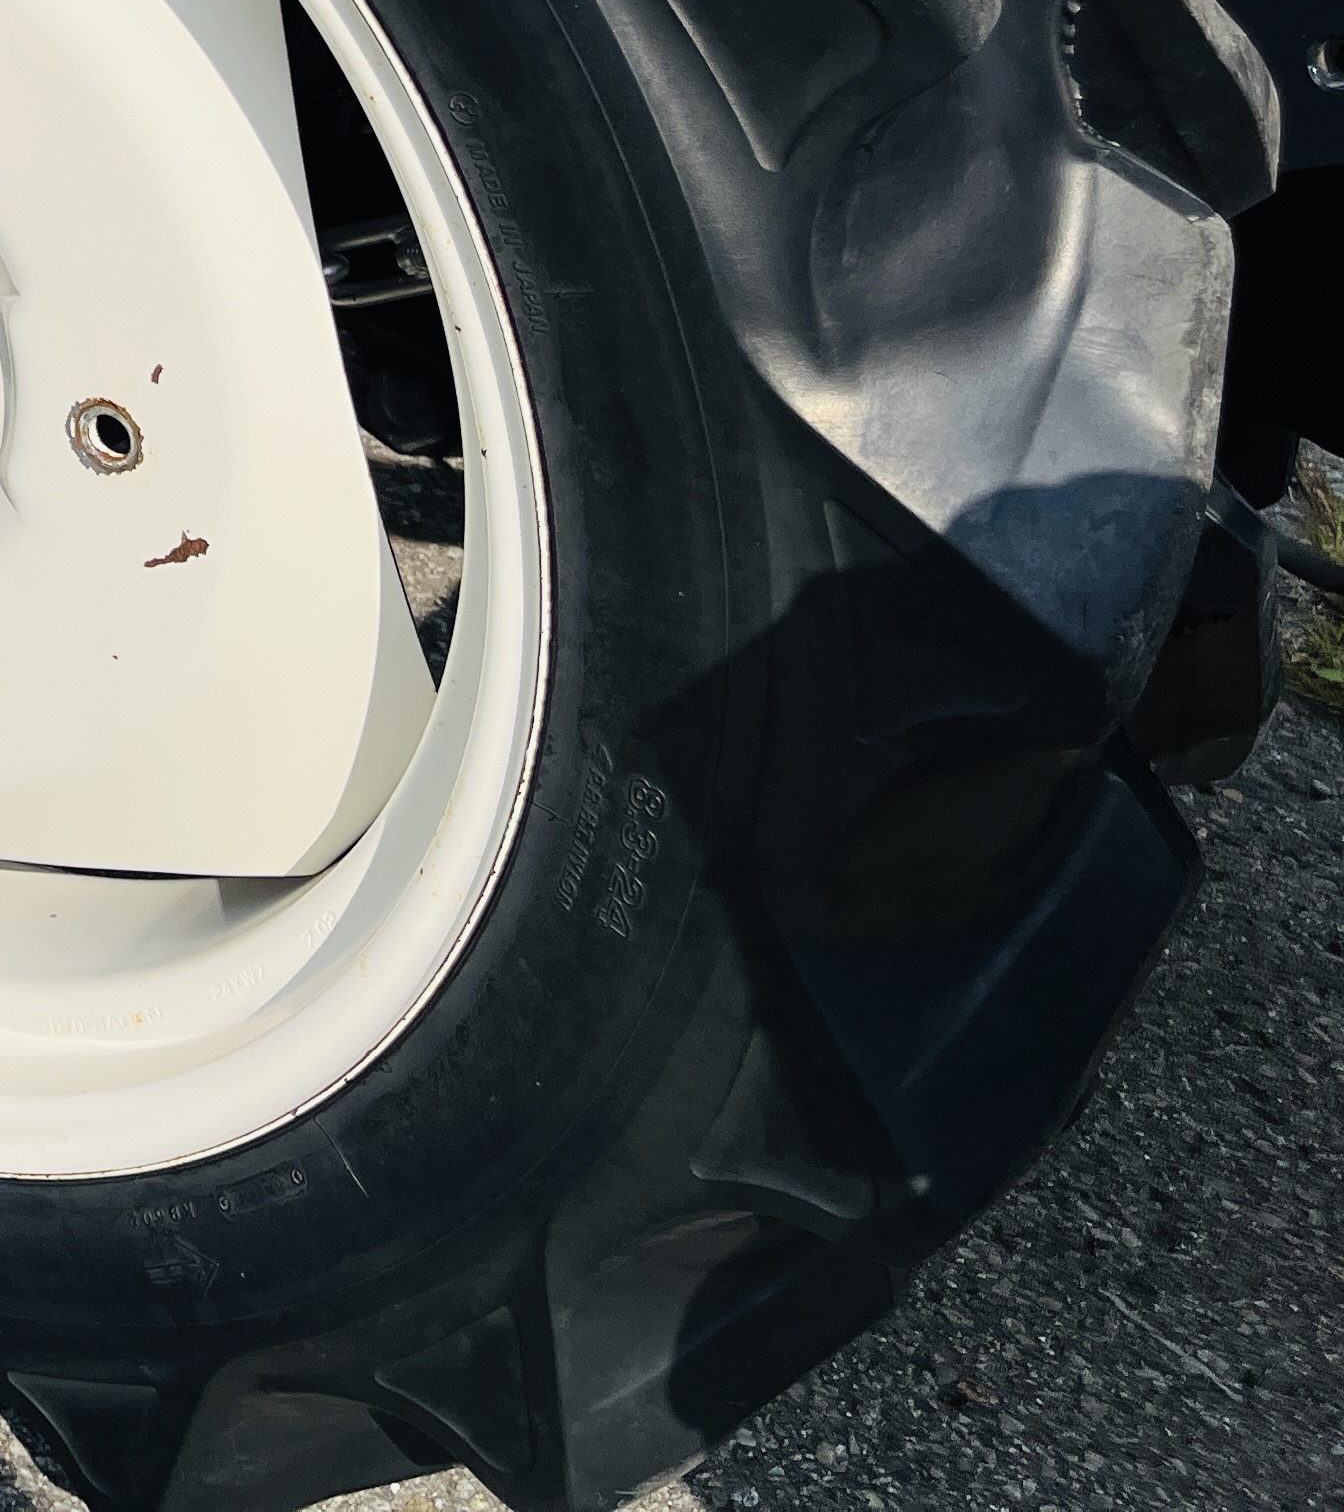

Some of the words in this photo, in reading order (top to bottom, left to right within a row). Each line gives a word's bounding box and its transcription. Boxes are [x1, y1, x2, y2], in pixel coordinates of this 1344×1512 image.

[465, 140, 509, 210] MADE
[498, 220, 523, 248] IN
[513, 261, 551, 335] JAPAN
[597, 777, 667, 939] 8.3-24
